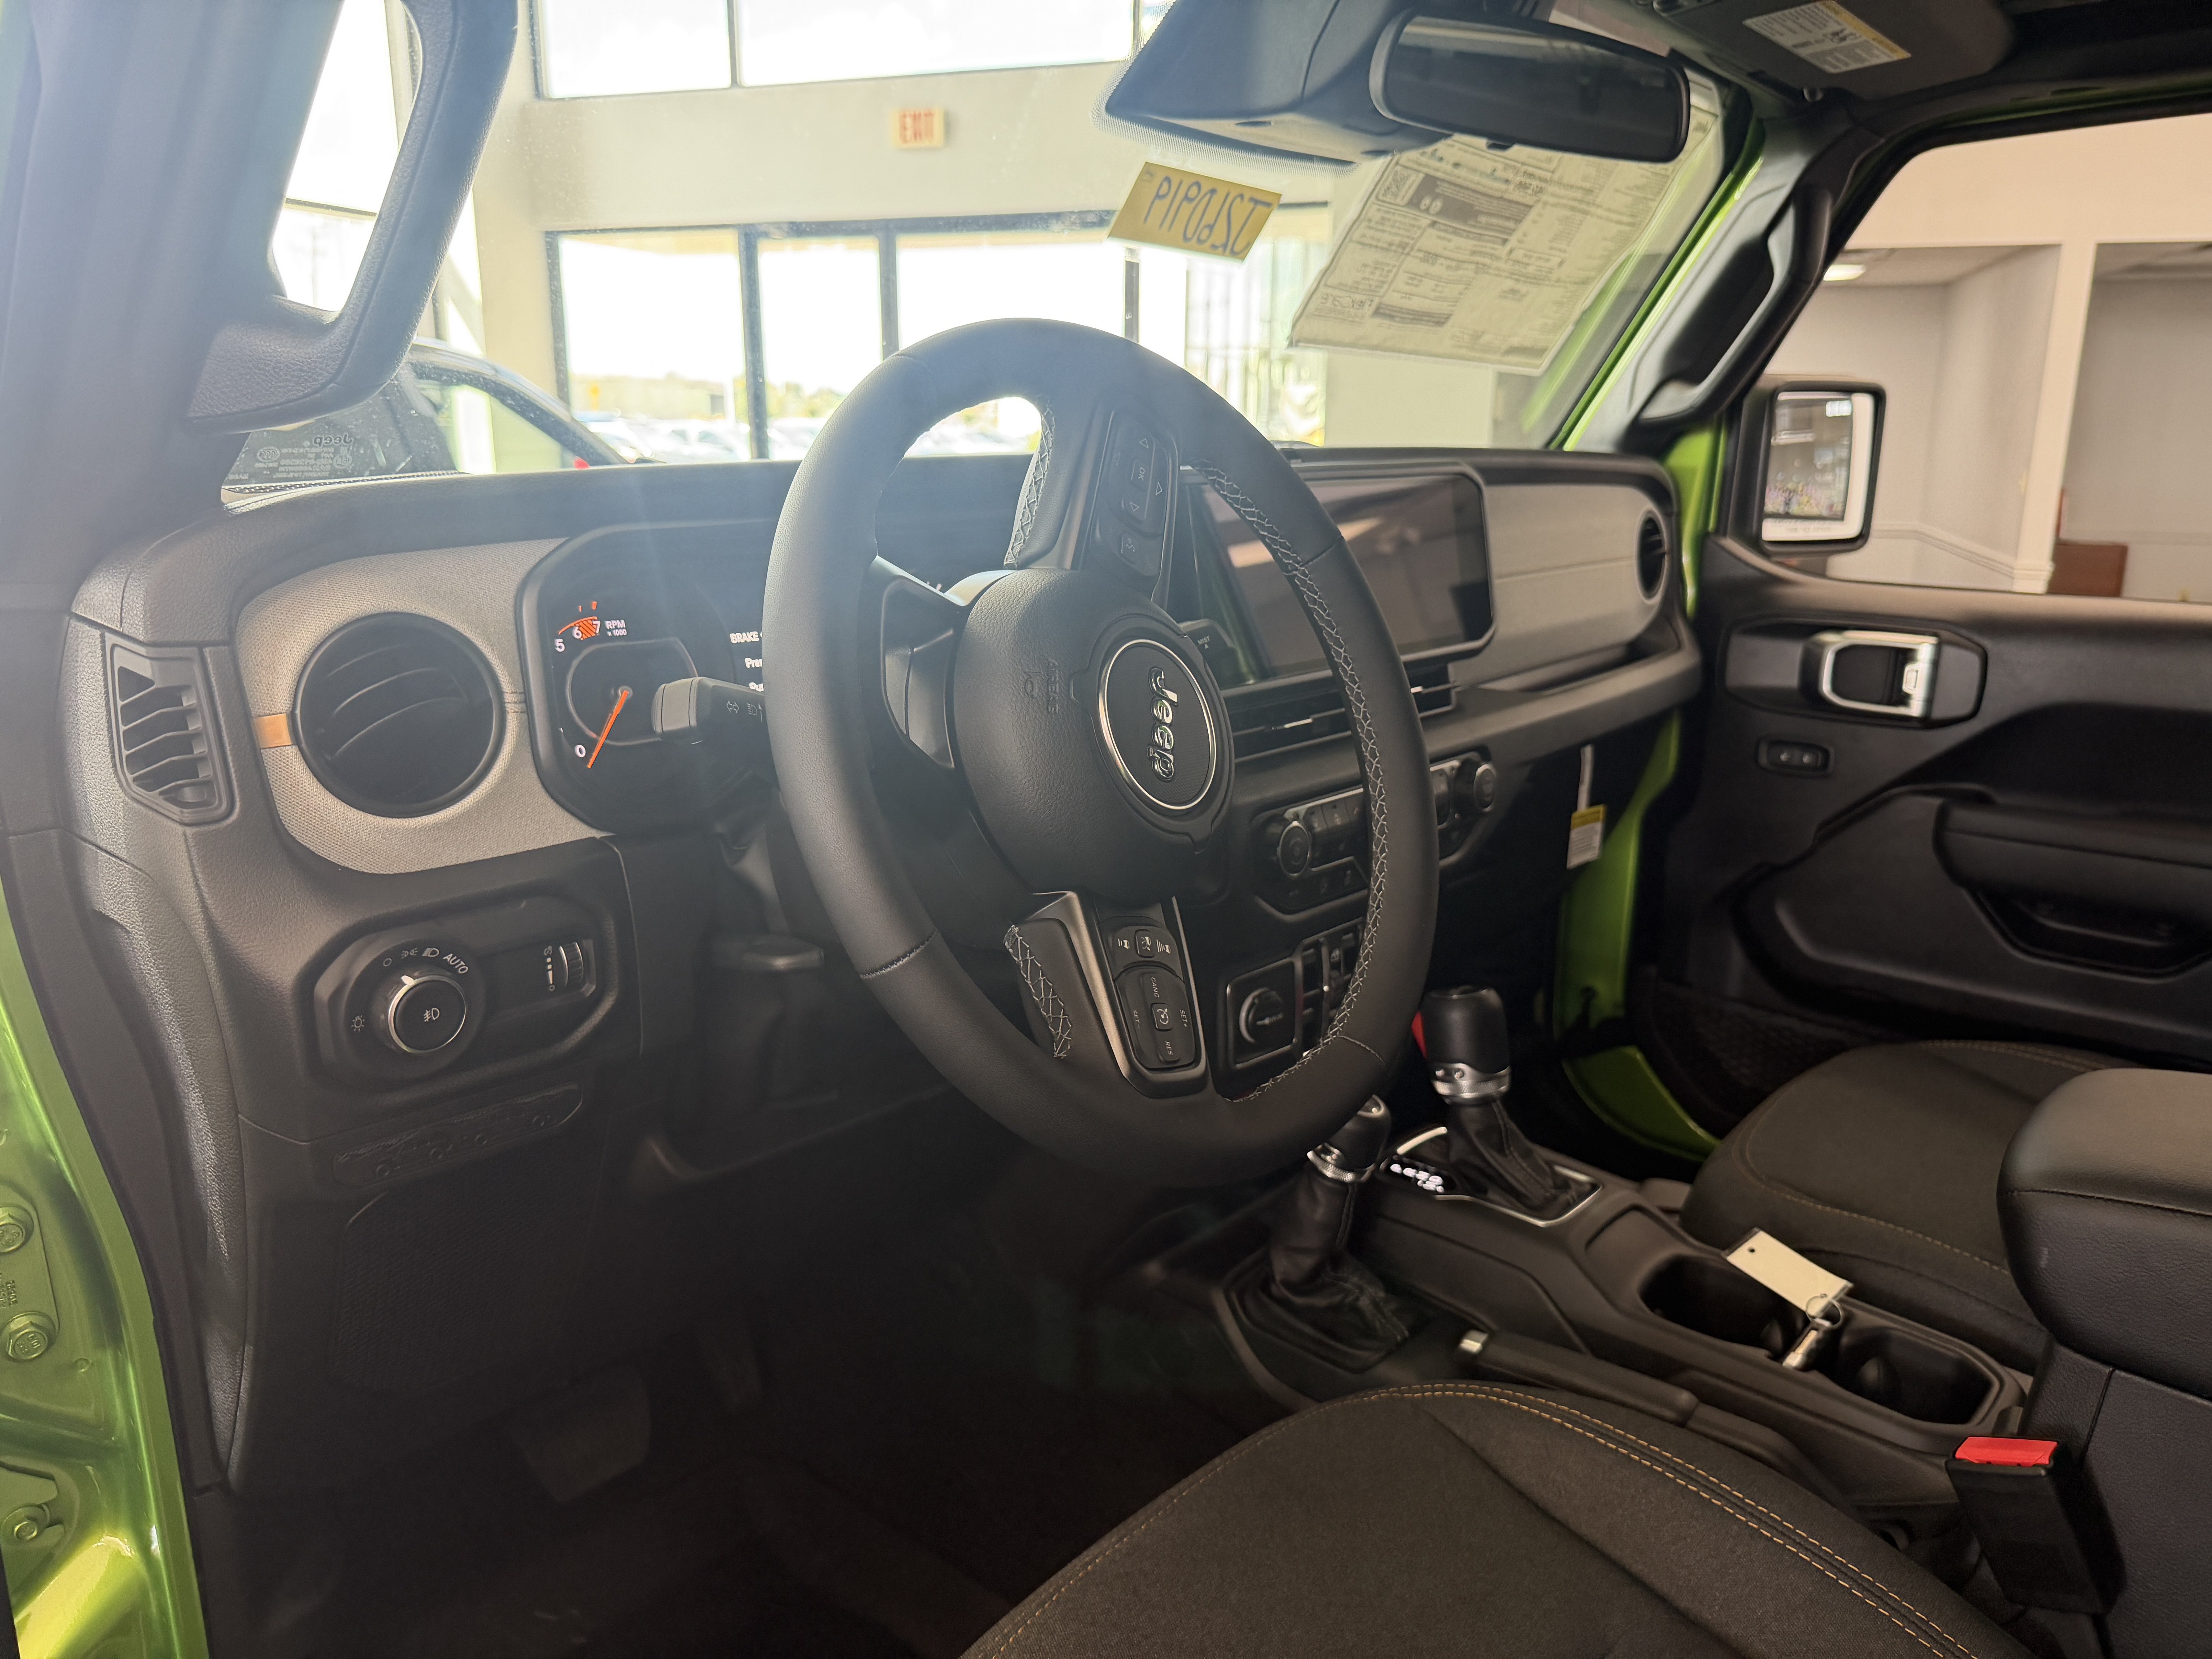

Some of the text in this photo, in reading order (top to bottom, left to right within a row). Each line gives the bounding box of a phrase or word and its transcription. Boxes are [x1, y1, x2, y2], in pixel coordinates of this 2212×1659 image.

[899, 111, 934, 144] EXIT
[1138, 467, 1145, 481] OK
[592, 620, 601, 634] 7
[605, 619, 626, 629] RPM
[572, 626, 582, 639] 6
[730, 631, 759, 644] BRAKE
[554, 638, 565, 653] 5
[1197, 635, 1210, 645] MIST
[1147, 666, 1178, 783] Jeep
[574, 744, 586, 758] 0
[443, 953, 468, 974] AUTO
[1151, 977, 1160, 998] CANC
[1164, 1041, 1173, 1056] RES
